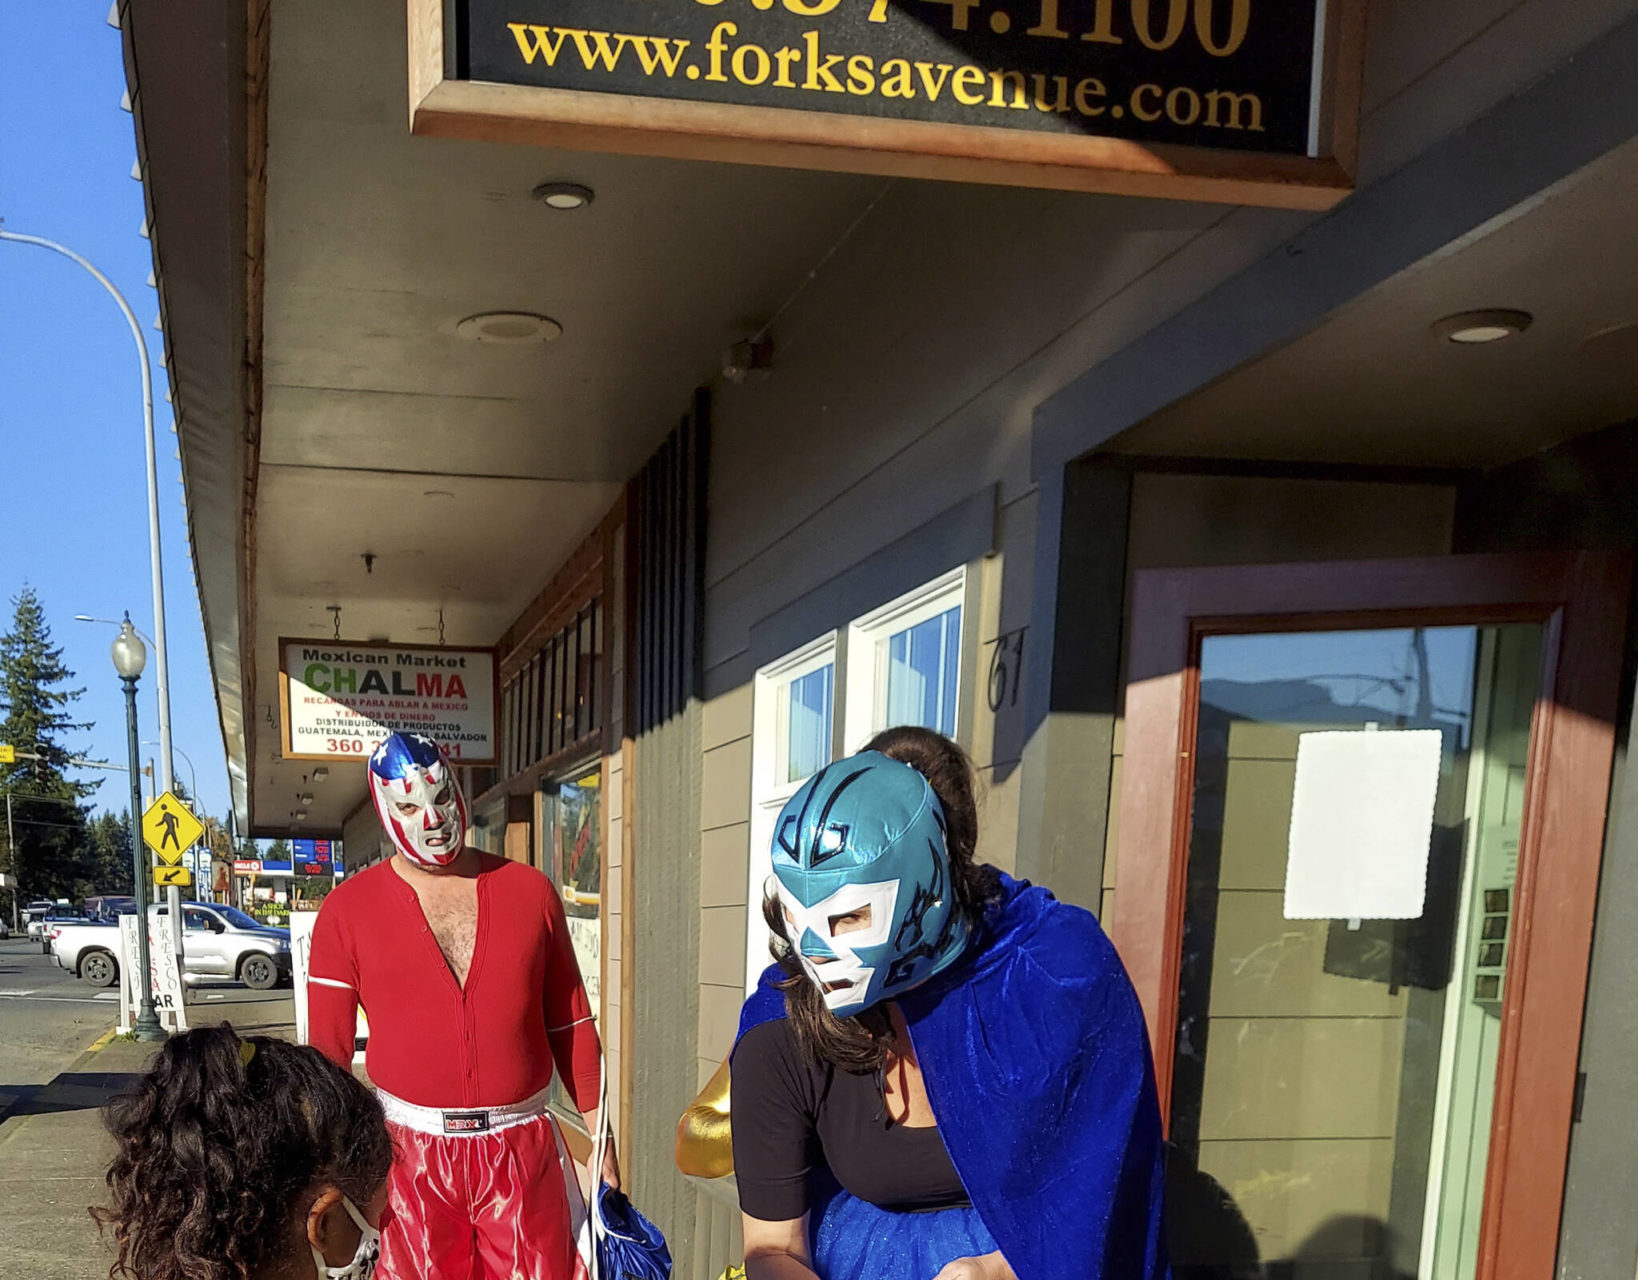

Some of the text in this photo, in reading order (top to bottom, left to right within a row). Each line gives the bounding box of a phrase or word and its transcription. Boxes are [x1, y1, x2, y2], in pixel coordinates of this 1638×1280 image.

[507, 22, 1264, 133] www.forksavenue.com
[303, 649, 467, 669] Mexican Market
[304, 663, 467, 699] CHALMA
[360, 698, 385, 707] PARA
[432, 702, 468, 711] MEXICO
[336, 710, 341, 718] Y
[345, 710, 383, 719] ENVIOS
[400, 713, 436, 721] DINERO
[316, 718, 461, 731] DISTRIBUIDOR DE PRODUCTOS
[298, 727, 364, 737] GUATEMALA,
[434, 733, 488, 742] SALVADOR
[327, 739, 363, 753] 360
